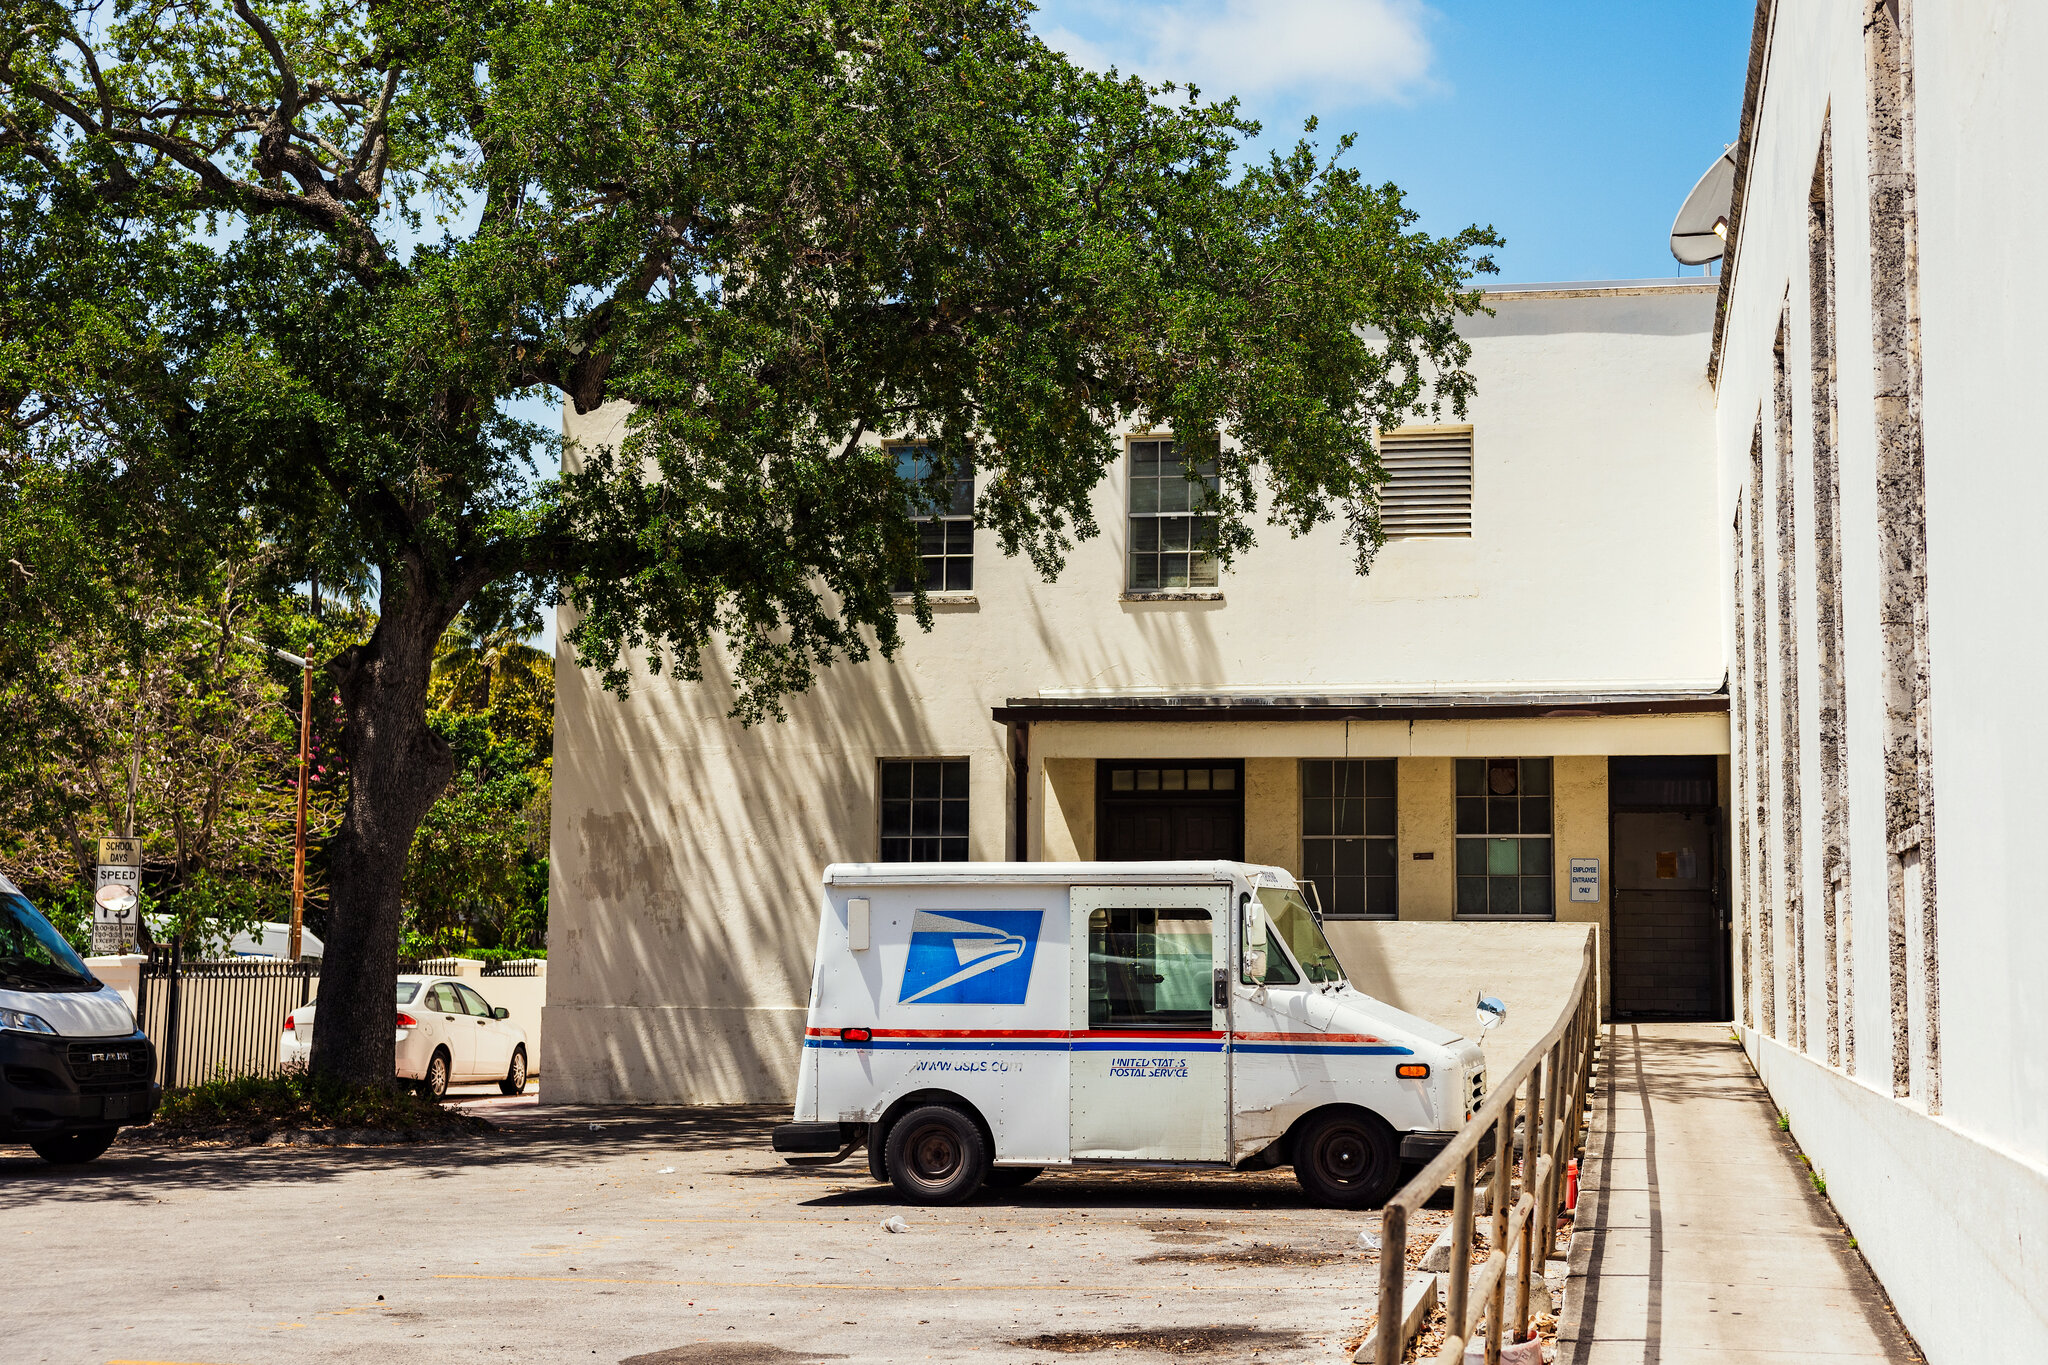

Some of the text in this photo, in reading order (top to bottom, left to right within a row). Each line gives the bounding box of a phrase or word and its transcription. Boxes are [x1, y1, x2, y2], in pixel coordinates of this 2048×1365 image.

[106, 841, 134, 851] SCHOOL
[110, 853, 128, 863] DAYS
[100, 870, 137, 880] SPEED
[91, 1052, 129, 1061] RAM
[1111, 1058, 1187, 1067] UNITED STATS
[1109, 1068, 1147, 1077] POSTAL
